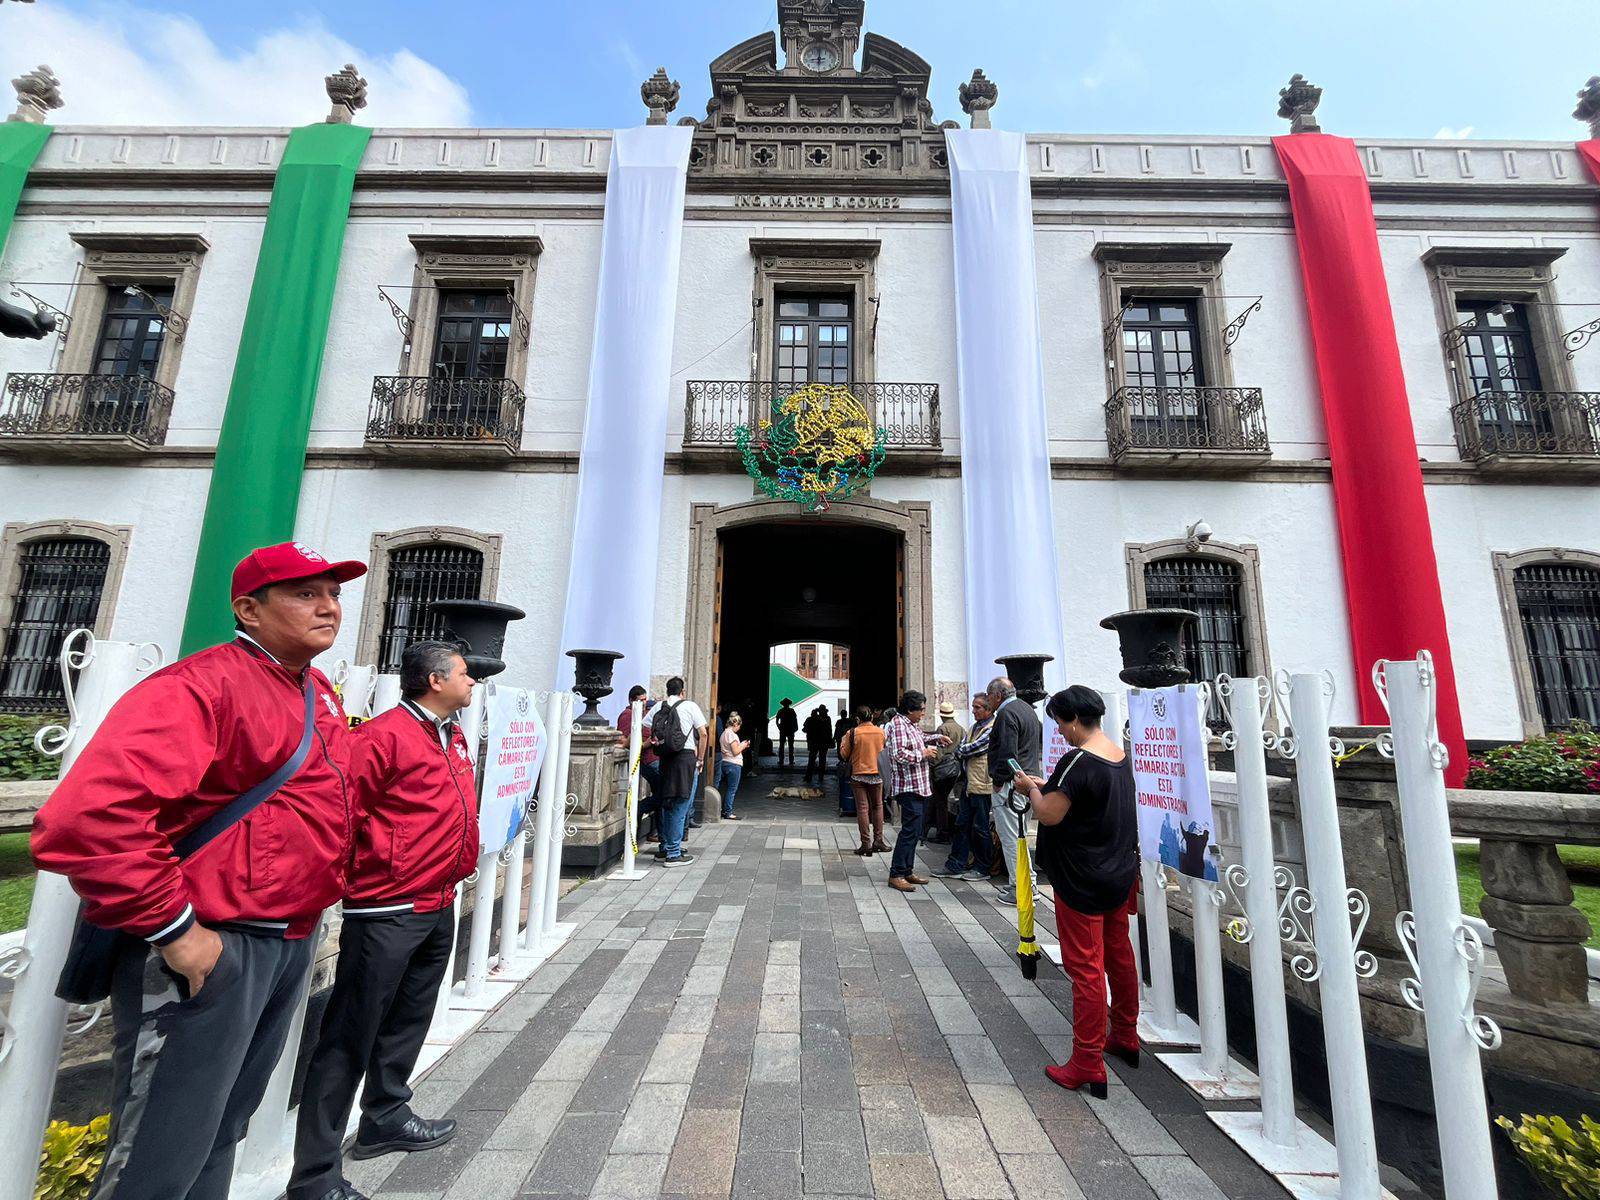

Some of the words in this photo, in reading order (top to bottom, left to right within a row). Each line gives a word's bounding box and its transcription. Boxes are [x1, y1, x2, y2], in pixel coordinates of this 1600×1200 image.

[769, 194, 825, 208] MARTE
[1144, 723, 1165, 741] SÓLO
[501, 736, 535, 749] REFLECTORES
[1135, 743, 1179, 759] REFLECTORES
[514, 766, 526, 779] ESTA
[1134, 757, 1170, 775] CÁMARAS
[1158, 778, 1173, 793] ESTA
